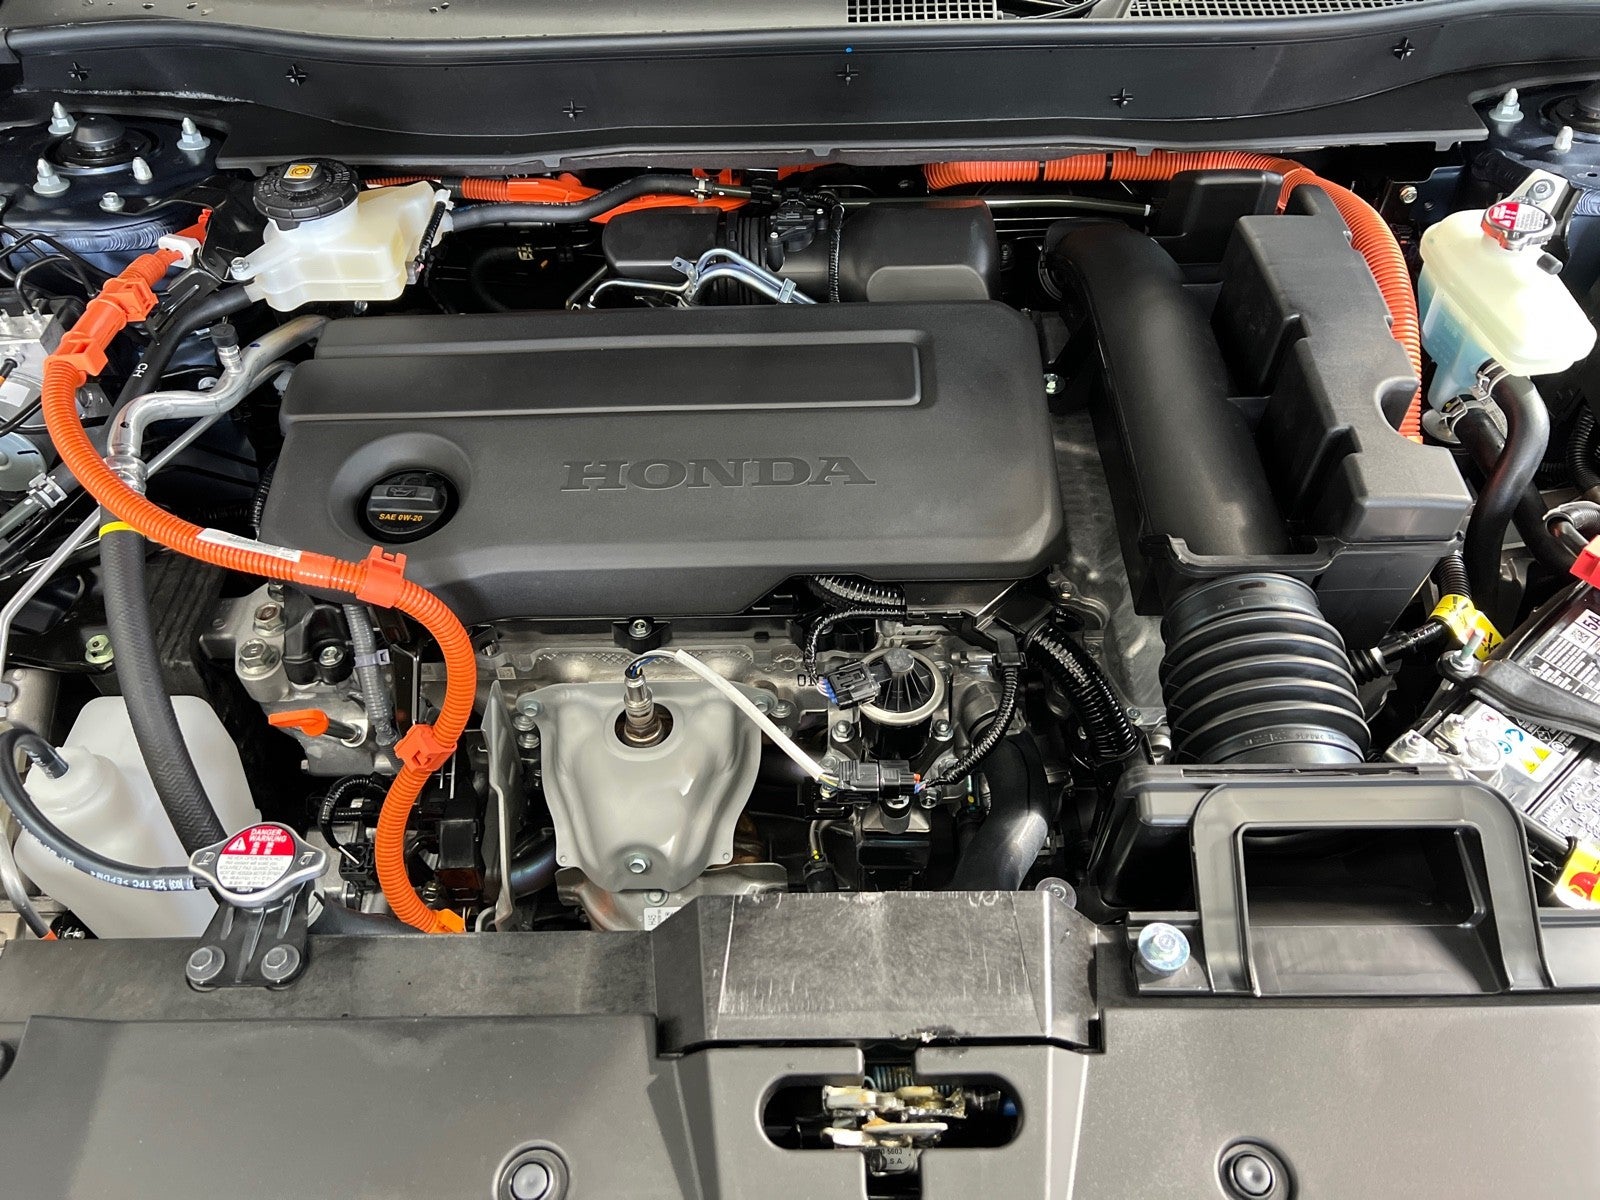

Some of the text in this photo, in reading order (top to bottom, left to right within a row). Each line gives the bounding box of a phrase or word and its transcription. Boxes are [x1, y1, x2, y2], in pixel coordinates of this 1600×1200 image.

[560, 456, 877, 492] HONDA
[378, 513, 423, 522] SAE 0W-20
[250, 828, 283, 836] DANGER
